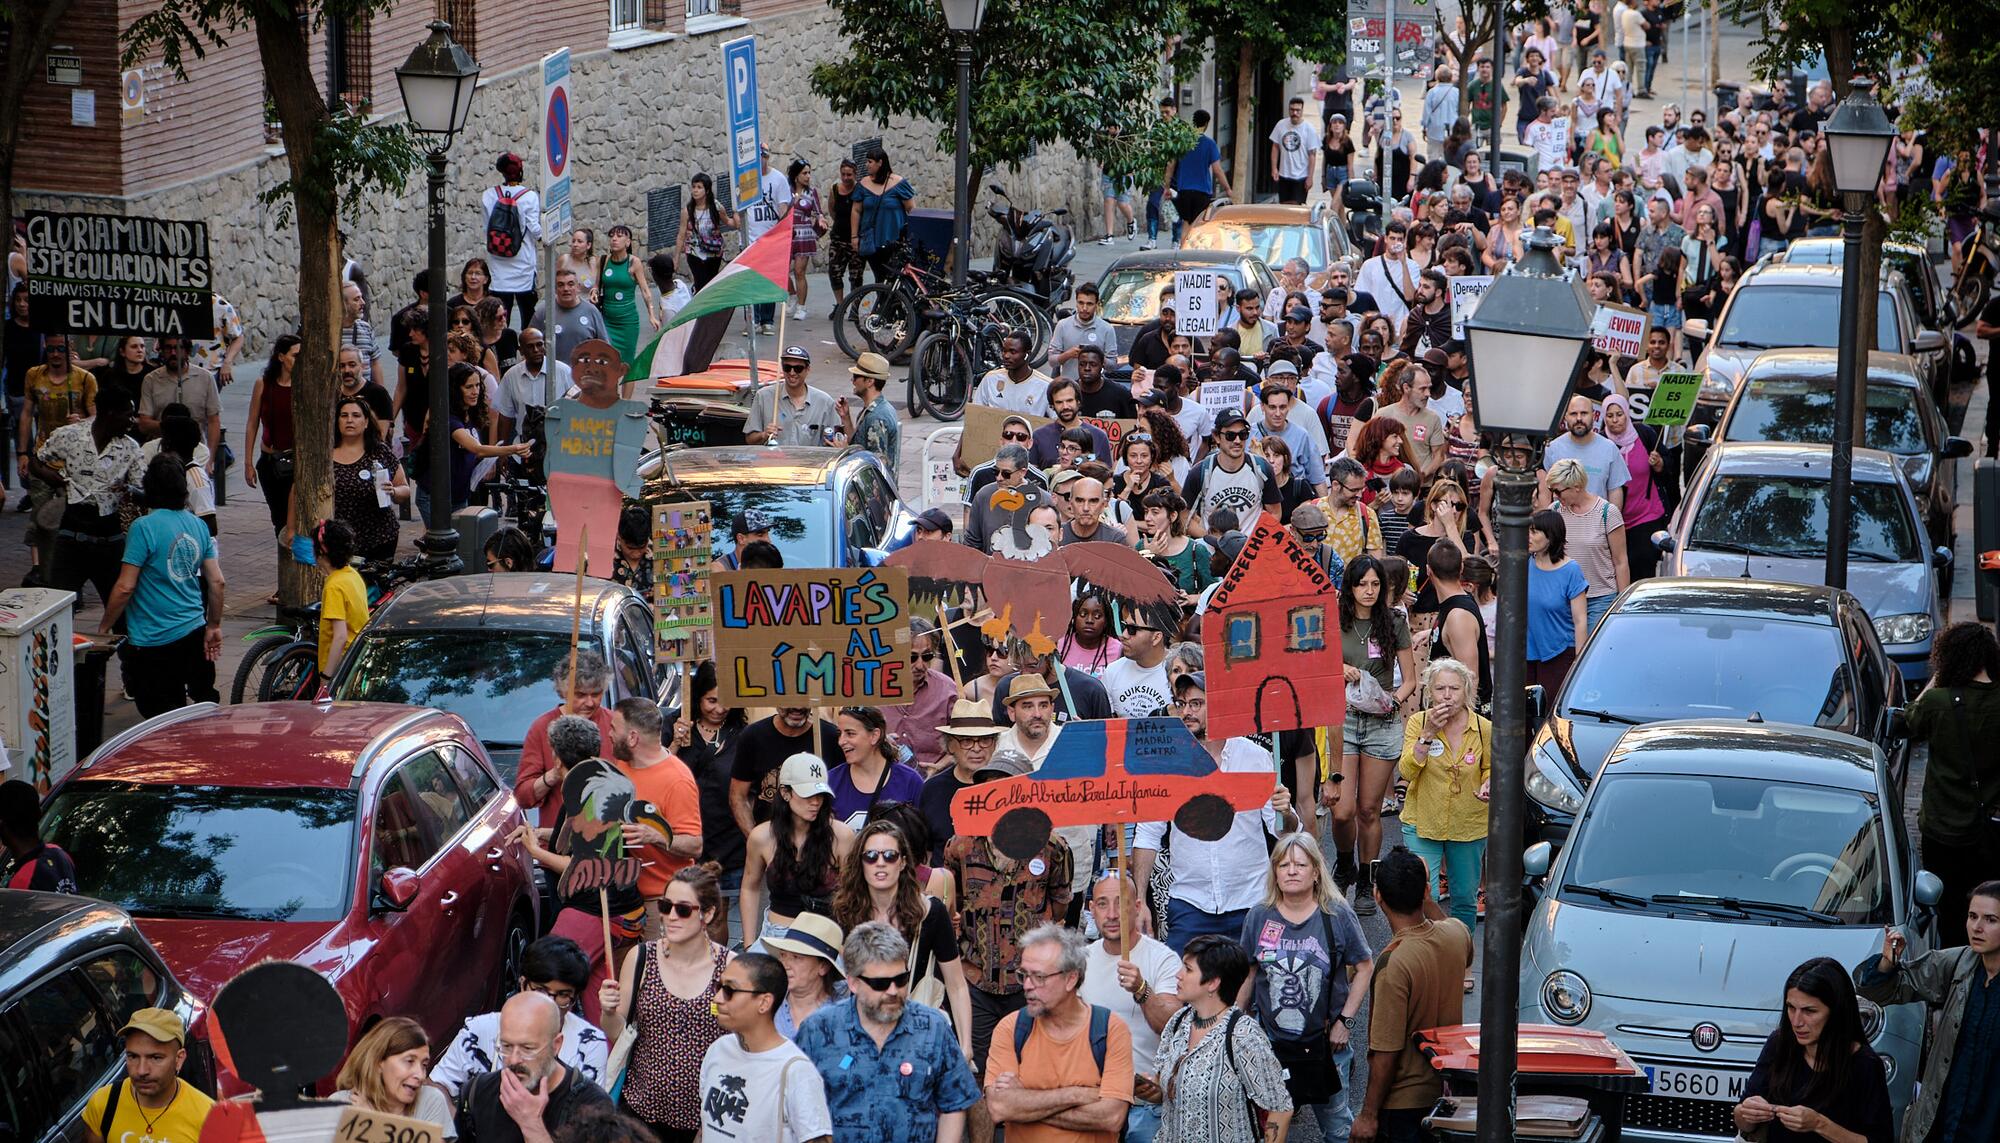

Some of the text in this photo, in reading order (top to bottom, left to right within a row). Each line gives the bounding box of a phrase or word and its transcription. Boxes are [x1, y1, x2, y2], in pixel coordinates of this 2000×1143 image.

[733, 56, 748, 114] P
[27, 248, 208, 288] ESPECULACIONES
[1179, 274, 1211, 292] ¡NADIE
[124, 287, 131, 300] Y
[1189, 296, 1201, 310] ES
[68, 300, 183, 335] EN LUCHA
[1663, 374, 1697, 385] NADIE
[1667, 391, 1681, 401] ES
[1648, 408, 1687, 419] ILEGAL
[570, 416, 615, 436] MAME
[1272, 530, 1285, 545] A
[1283, 540, 1331, 595] TECHO!
[847, 628, 893, 657] AL
[1120, 685, 1166, 707] QUIKSILVER
[1135, 746, 1177, 756] CENTRO
[810, 764, 822, 778] NY
[1700, 1031, 1714, 1044] FIAT
[1659, 1071, 1719, 1096] 5660
